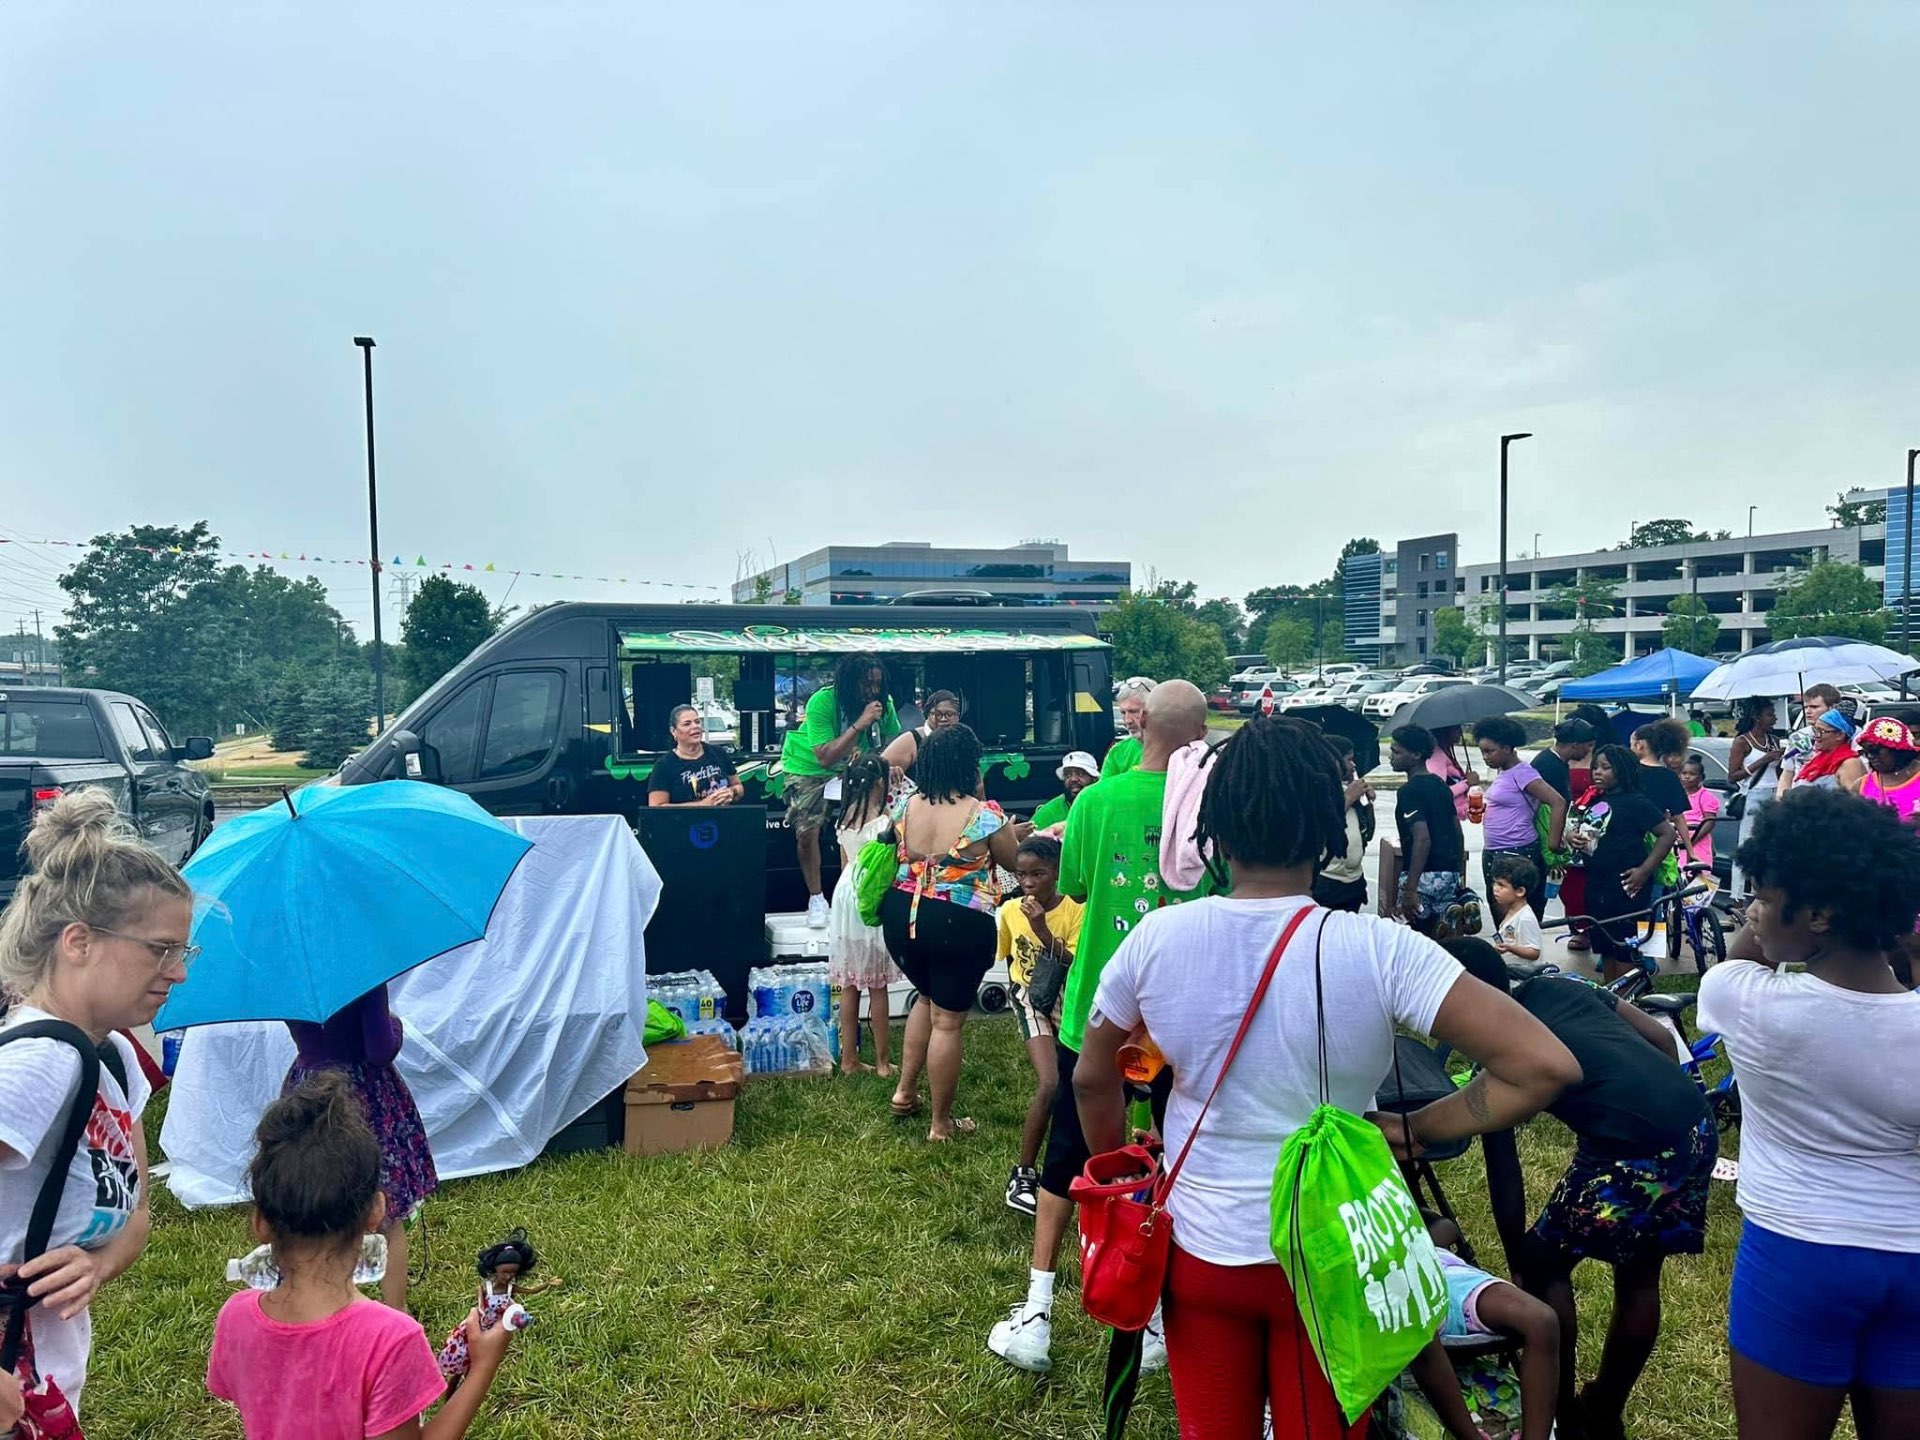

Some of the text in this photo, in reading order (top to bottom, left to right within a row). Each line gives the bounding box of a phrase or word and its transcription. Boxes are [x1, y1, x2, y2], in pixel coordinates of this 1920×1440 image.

[766, 819, 791, 829] ive C
[700, 1000, 713, 1008] 40
[796, 1000, 809, 1008] Life
